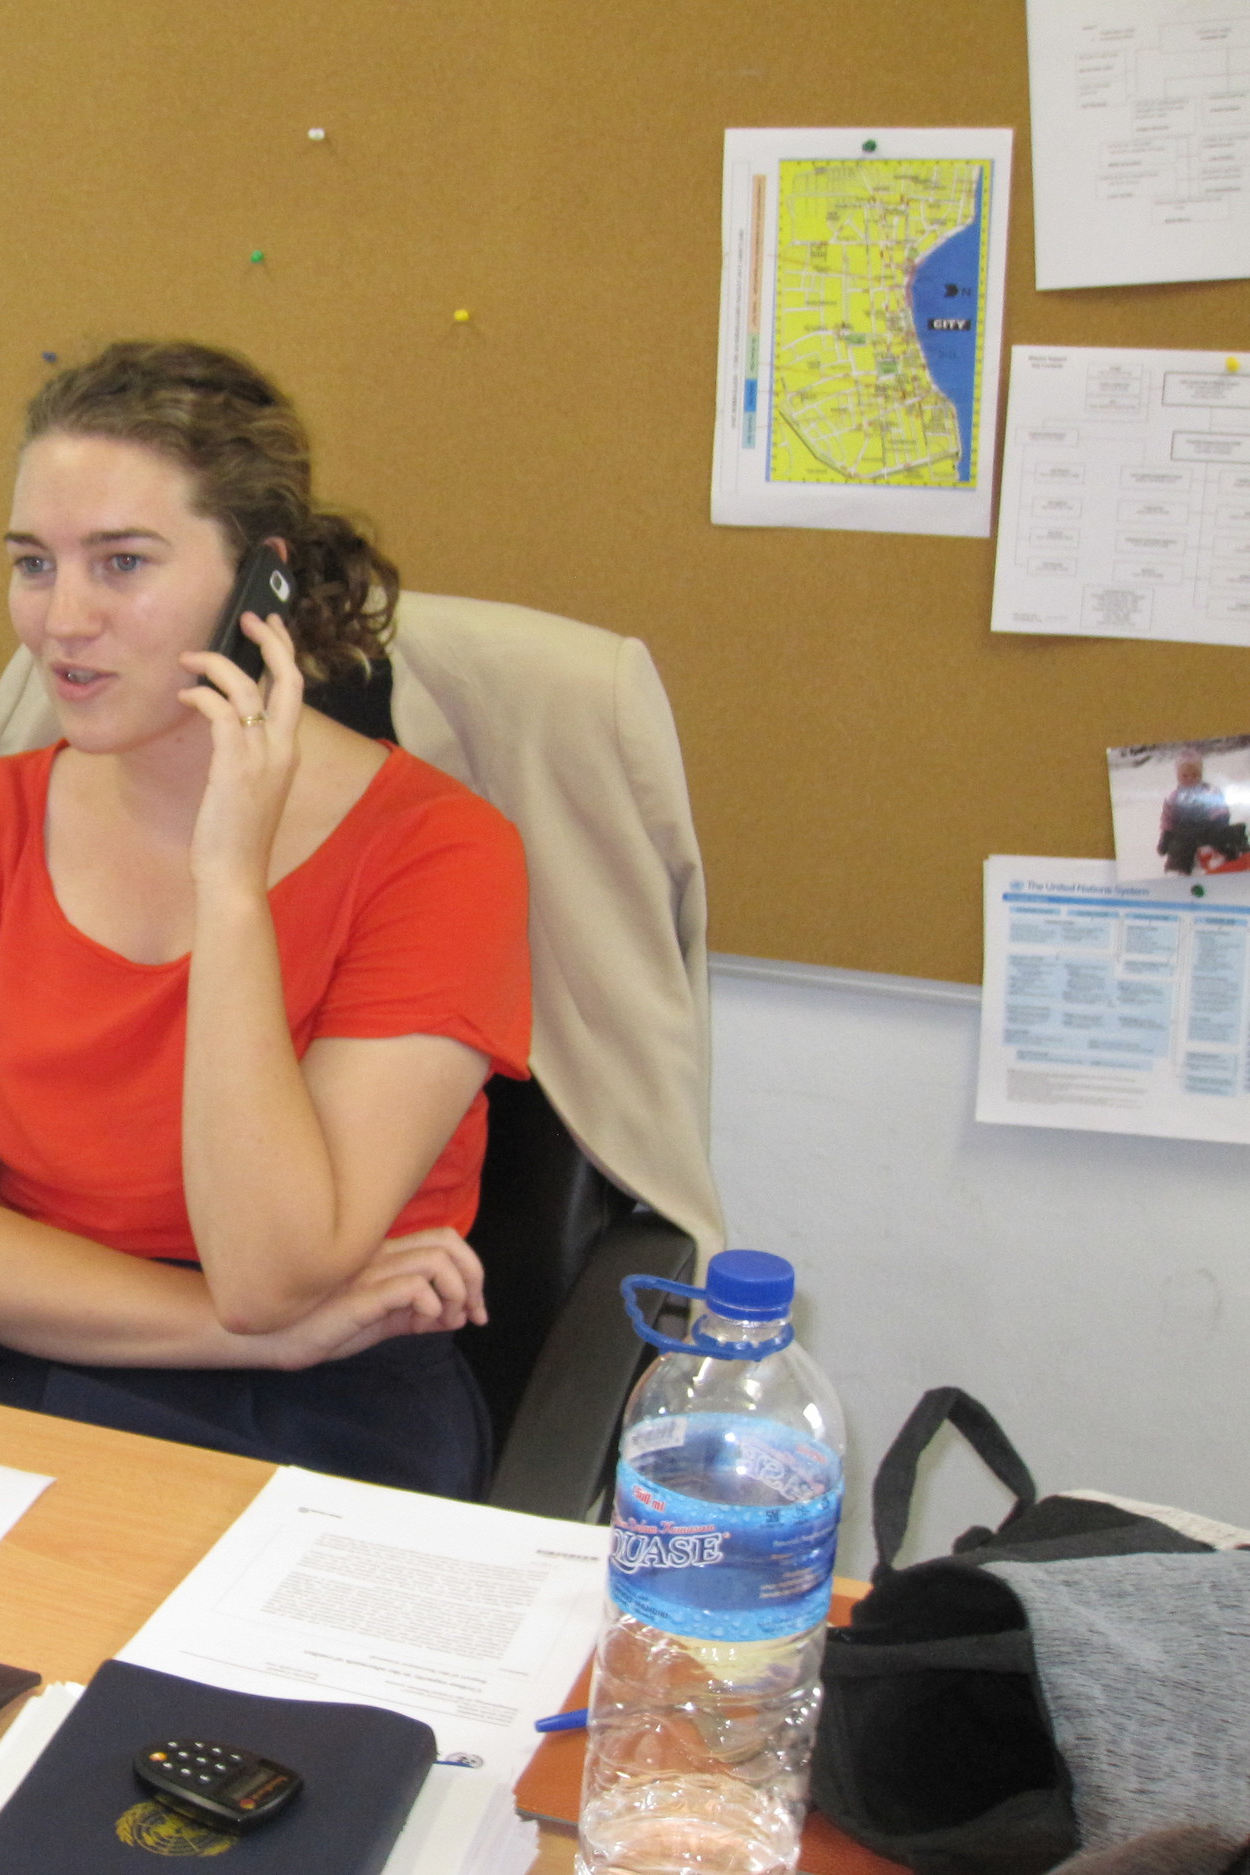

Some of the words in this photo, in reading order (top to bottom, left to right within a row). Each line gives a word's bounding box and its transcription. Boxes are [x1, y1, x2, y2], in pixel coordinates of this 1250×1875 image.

[932, 319, 966, 331] CITY
[1027, 880, 1044, 891] The
[1046, 882, 1076, 892] United
